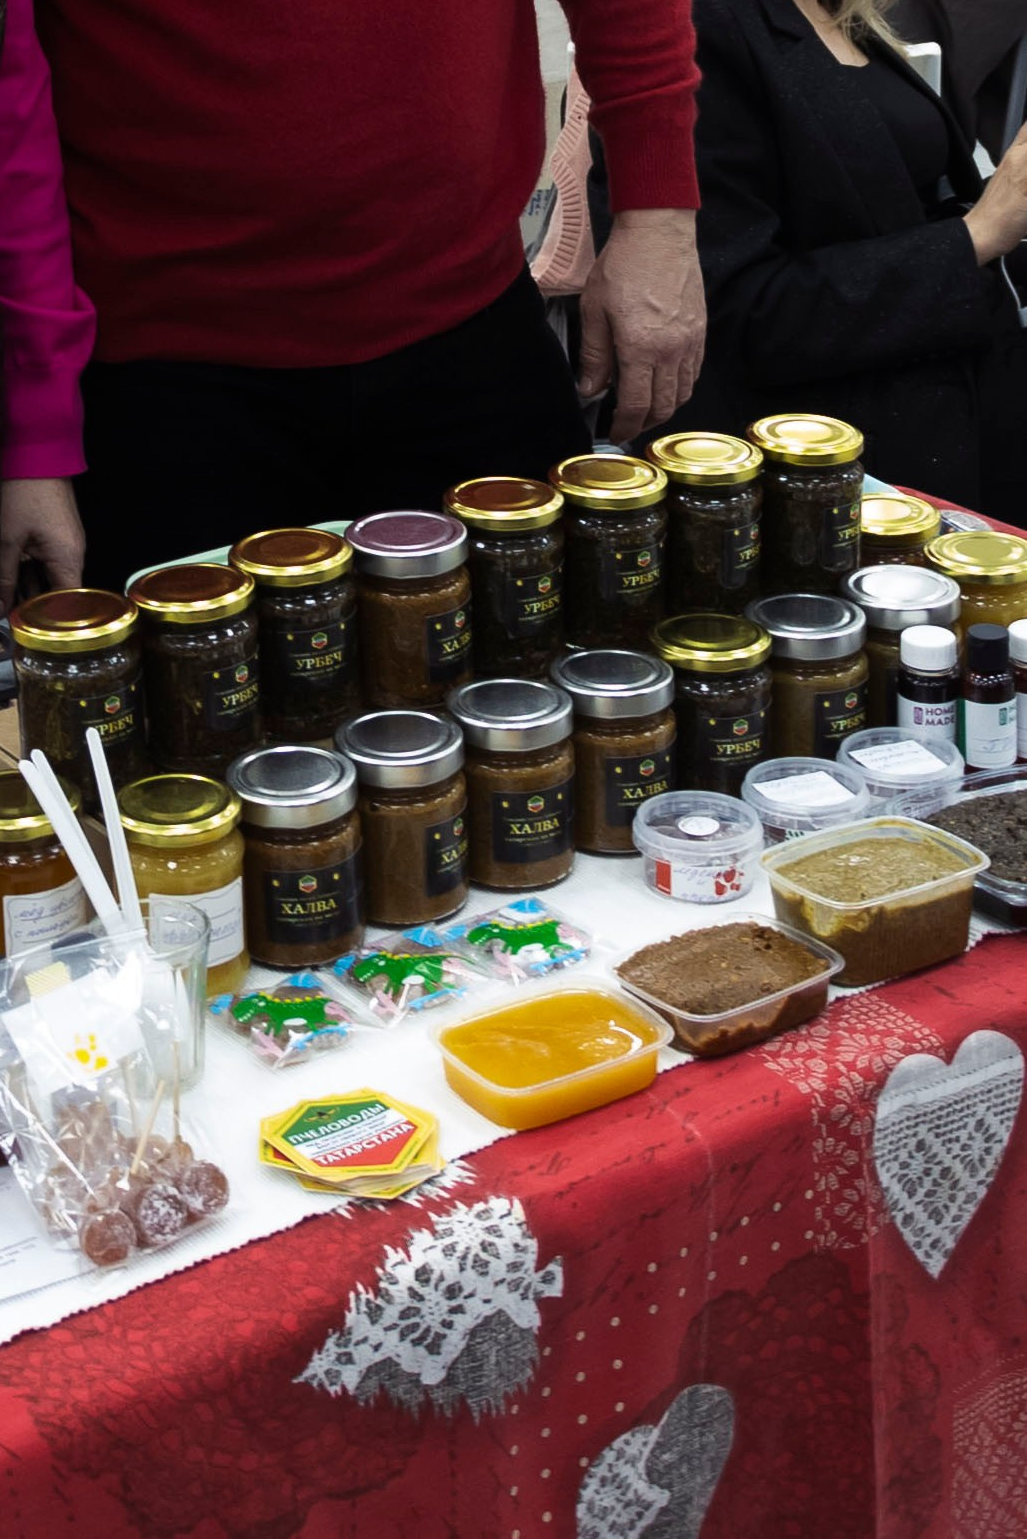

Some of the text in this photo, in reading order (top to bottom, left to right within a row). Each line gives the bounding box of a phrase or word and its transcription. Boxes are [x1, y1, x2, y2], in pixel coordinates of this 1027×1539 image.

[622, 569, 660, 587] УРБЕЧ
[524, 594, 561, 613] УРБЕЧ
[296, 651, 343, 670] УРБЕЧ
[222, 682, 259, 708] УРБЕЧ
[94, 714, 134, 736] РБЕЧ
[716, 738, 761, 755] УРБЕЧ
[623, 780, 669, 800] ХАЛВА
[510, 817, 560, 835] ХАЛВА
[281, 897, 338, 915] ХАЛВА
[287, 1102, 386, 1145] ПЧЕЛОВОДЫ
[315, 1122, 416, 1165] ТАТАРСТАНА
